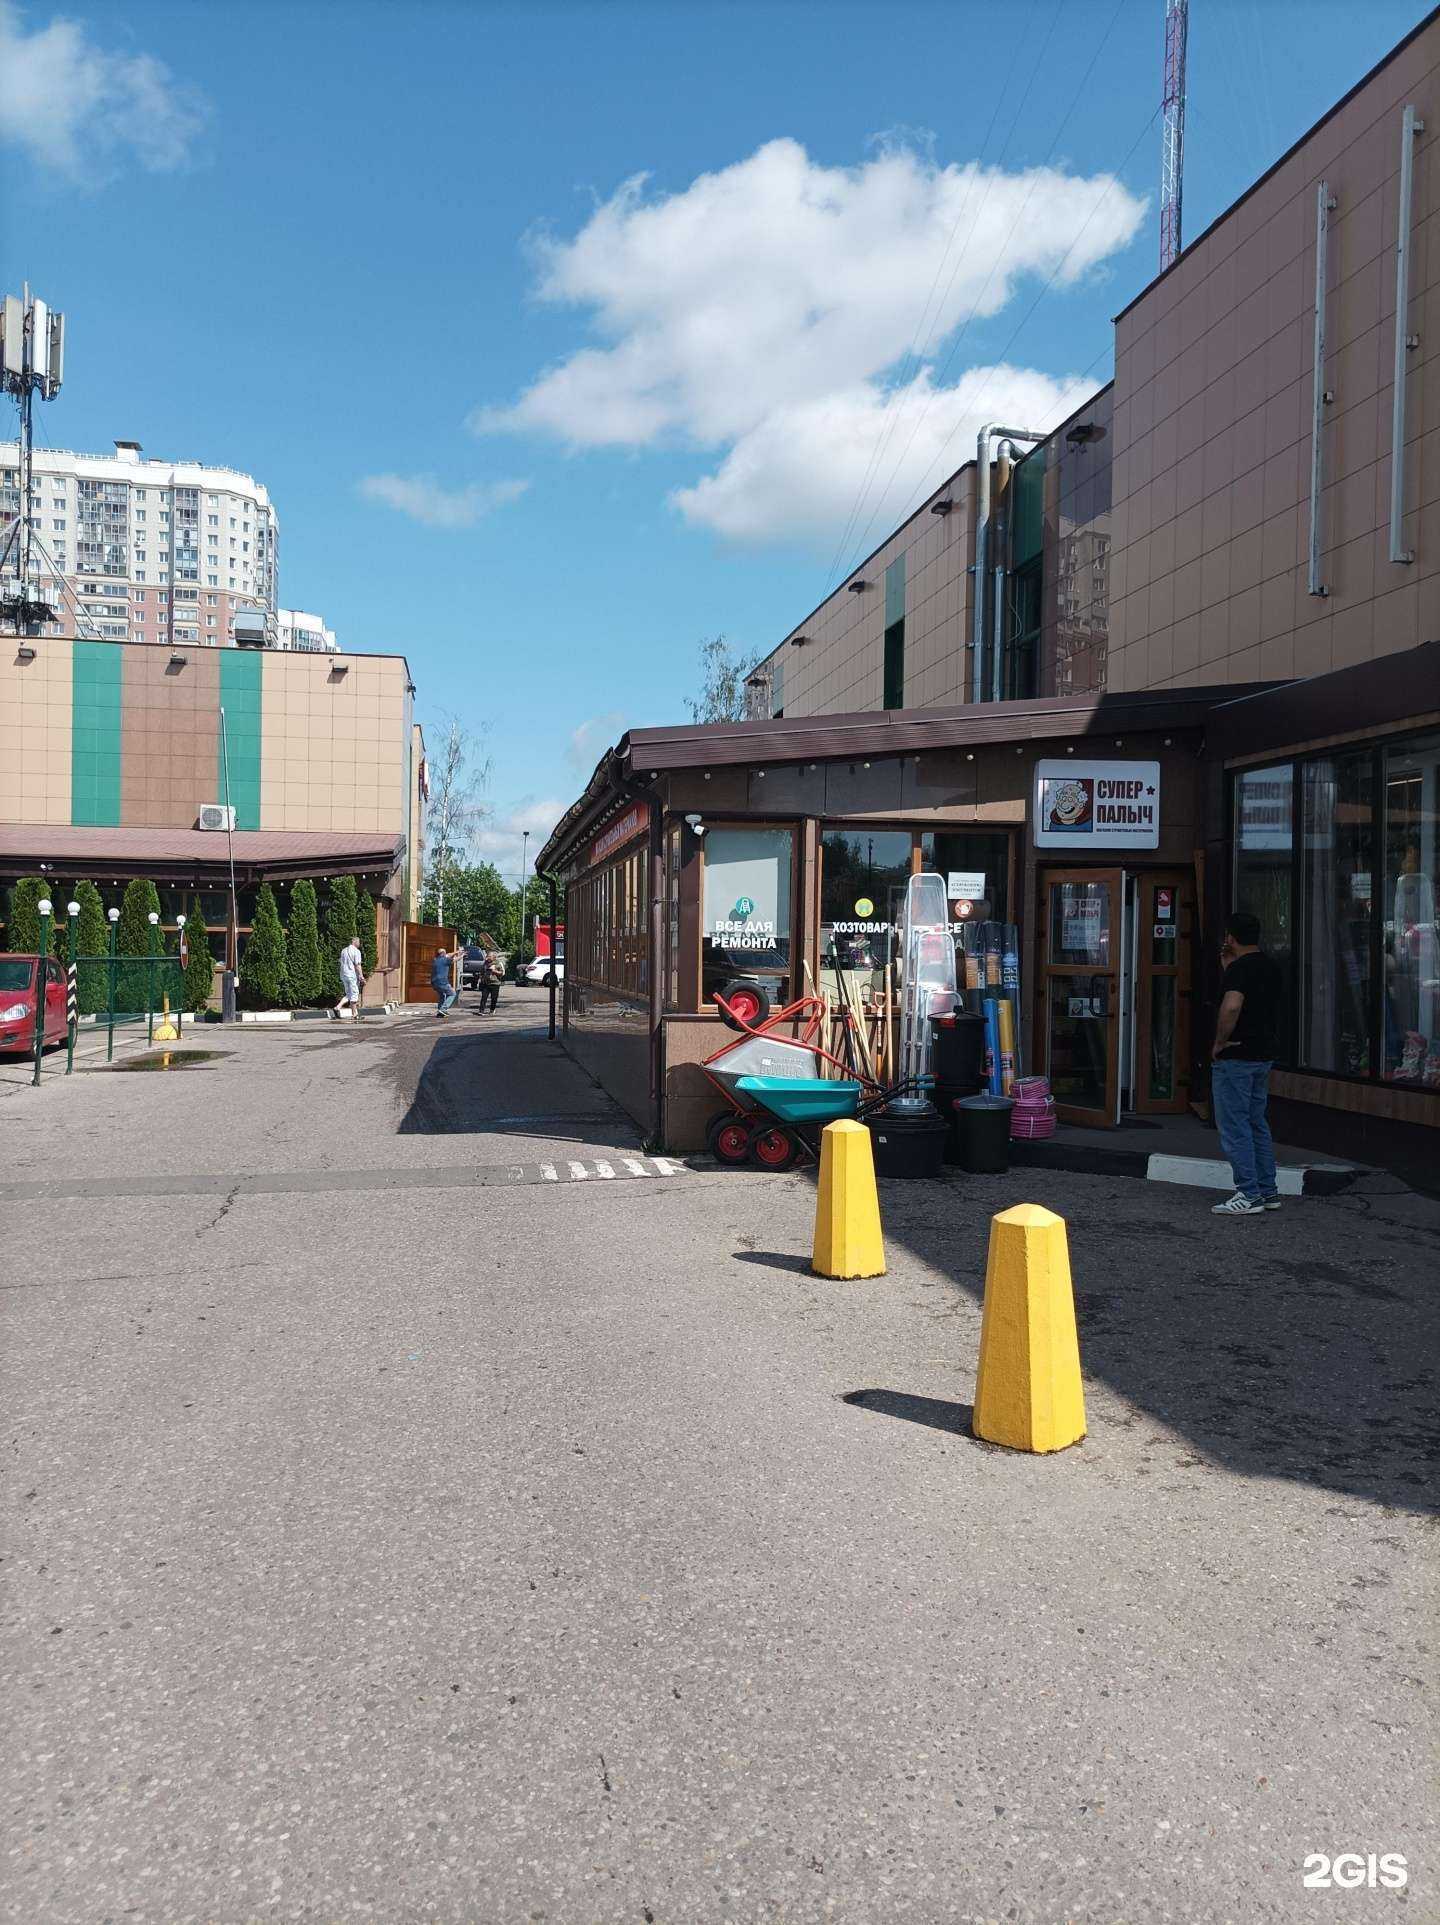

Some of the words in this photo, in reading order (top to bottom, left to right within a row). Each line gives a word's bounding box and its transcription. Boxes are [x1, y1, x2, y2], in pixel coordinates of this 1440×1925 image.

[1097, 780, 1143, 799] СУПЕР
[1097, 805, 1153, 824] ПАЛЫЧ
[715, 920, 743, 932] ВСЕ
[745, 920, 774, 933] ДЛЯ
[832, 922, 898, 933] ХОЗТОВАРЫ
[711, 936, 777, 949] РЕМОНТА
